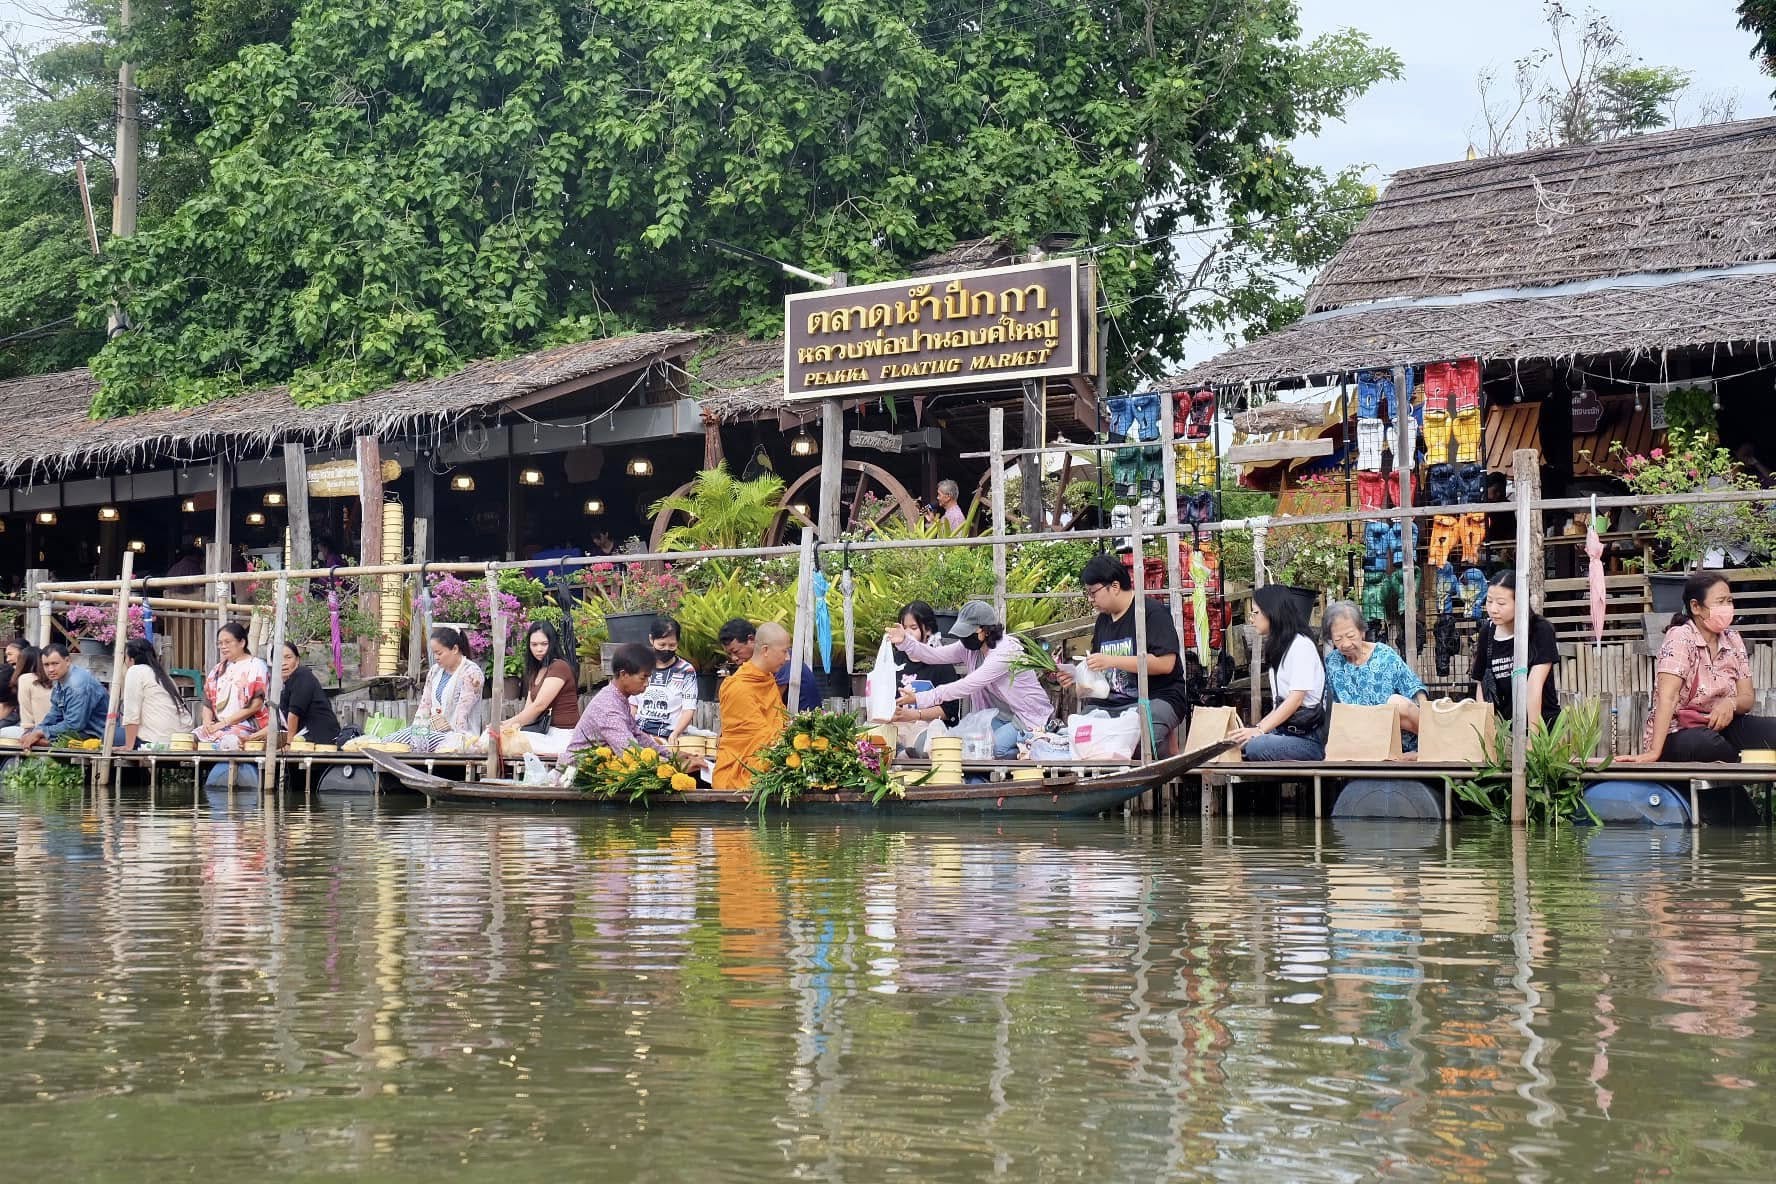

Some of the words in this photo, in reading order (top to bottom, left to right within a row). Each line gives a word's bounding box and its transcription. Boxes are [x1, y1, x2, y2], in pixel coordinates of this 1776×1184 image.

[807, 280, 1047, 335] ตลาดน้ำปีกกา
[798, 308, 1059, 363] หลวงพ่อปานองค์ใหญ่
[804, 367, 869, 386] PEAKKA
[880, 359, 962, 378] FLOATING
[969, 349, 1050, 371] MARKET
